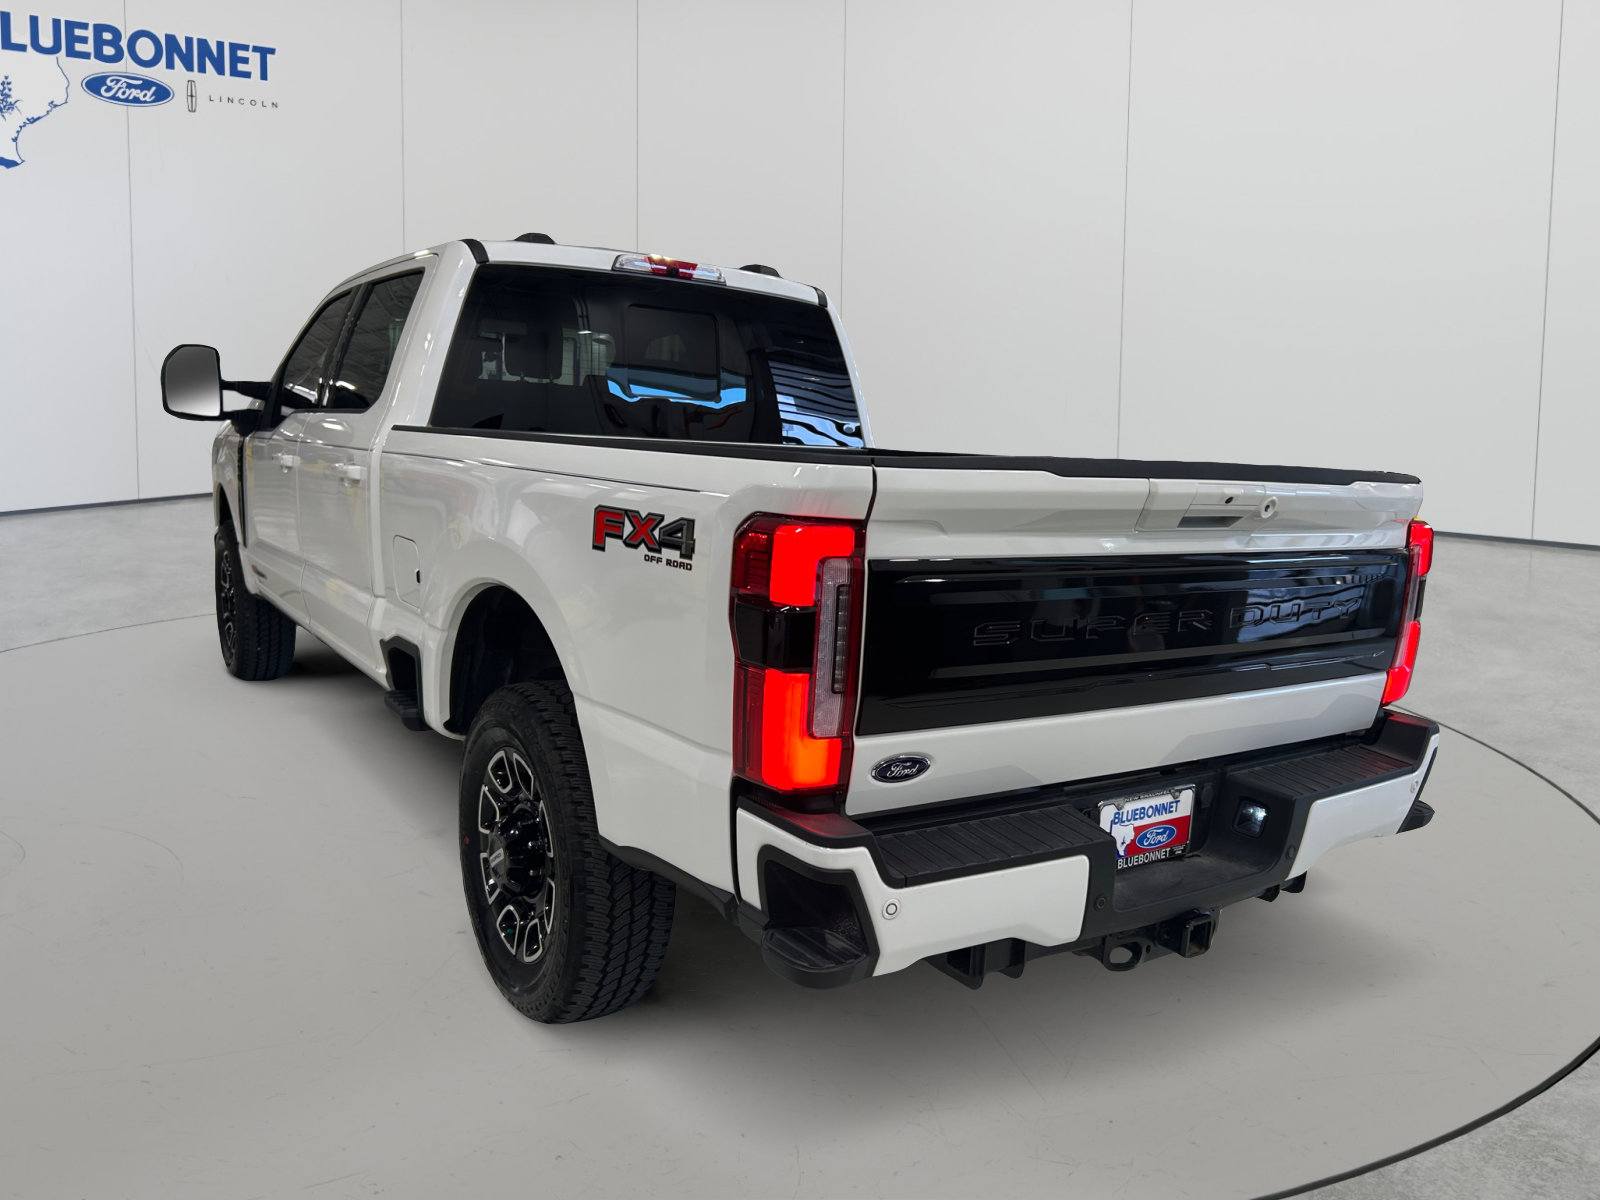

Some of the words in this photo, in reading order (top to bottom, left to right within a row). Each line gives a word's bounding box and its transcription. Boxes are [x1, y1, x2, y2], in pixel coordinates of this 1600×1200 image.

[100, 75, 157, 103] Ford
[208, 95, 279, 109] LINCOLN
[592, 504, 696, 561] FX4
[643, 554, 663, 565] OFF
[665, 558, 693, 572] ROAD
[973, 610, 1213, 646] SUPER
[1229, 597, 1363, 629] DUTY
[886, 761, 919, 778] Ford
[1112, 800, 1180, 825] BLUEBONNET
[1143, 828, 1169, 846] Ford
[1117, 847, 1171, 869] BLUEBONNET
